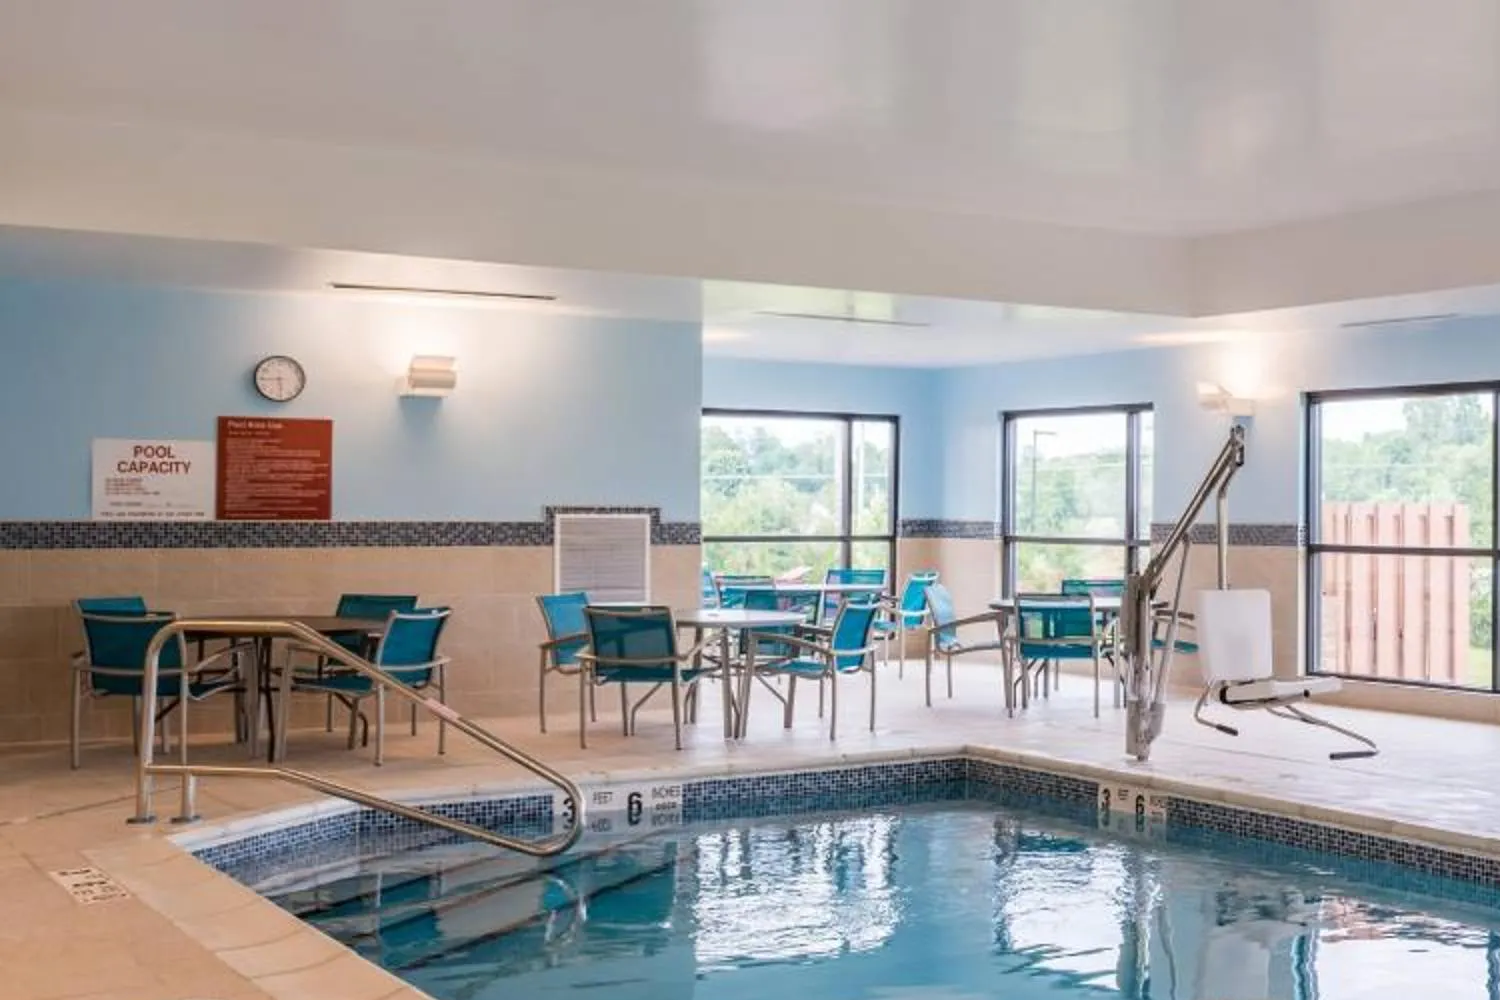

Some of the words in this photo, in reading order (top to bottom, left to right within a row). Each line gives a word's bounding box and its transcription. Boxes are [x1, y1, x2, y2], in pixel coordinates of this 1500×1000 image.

[133, 445, 175, 459] POOL
[116, 460, 192, 475] CAPACITY
[1135, 794, 1145, 815] 6
